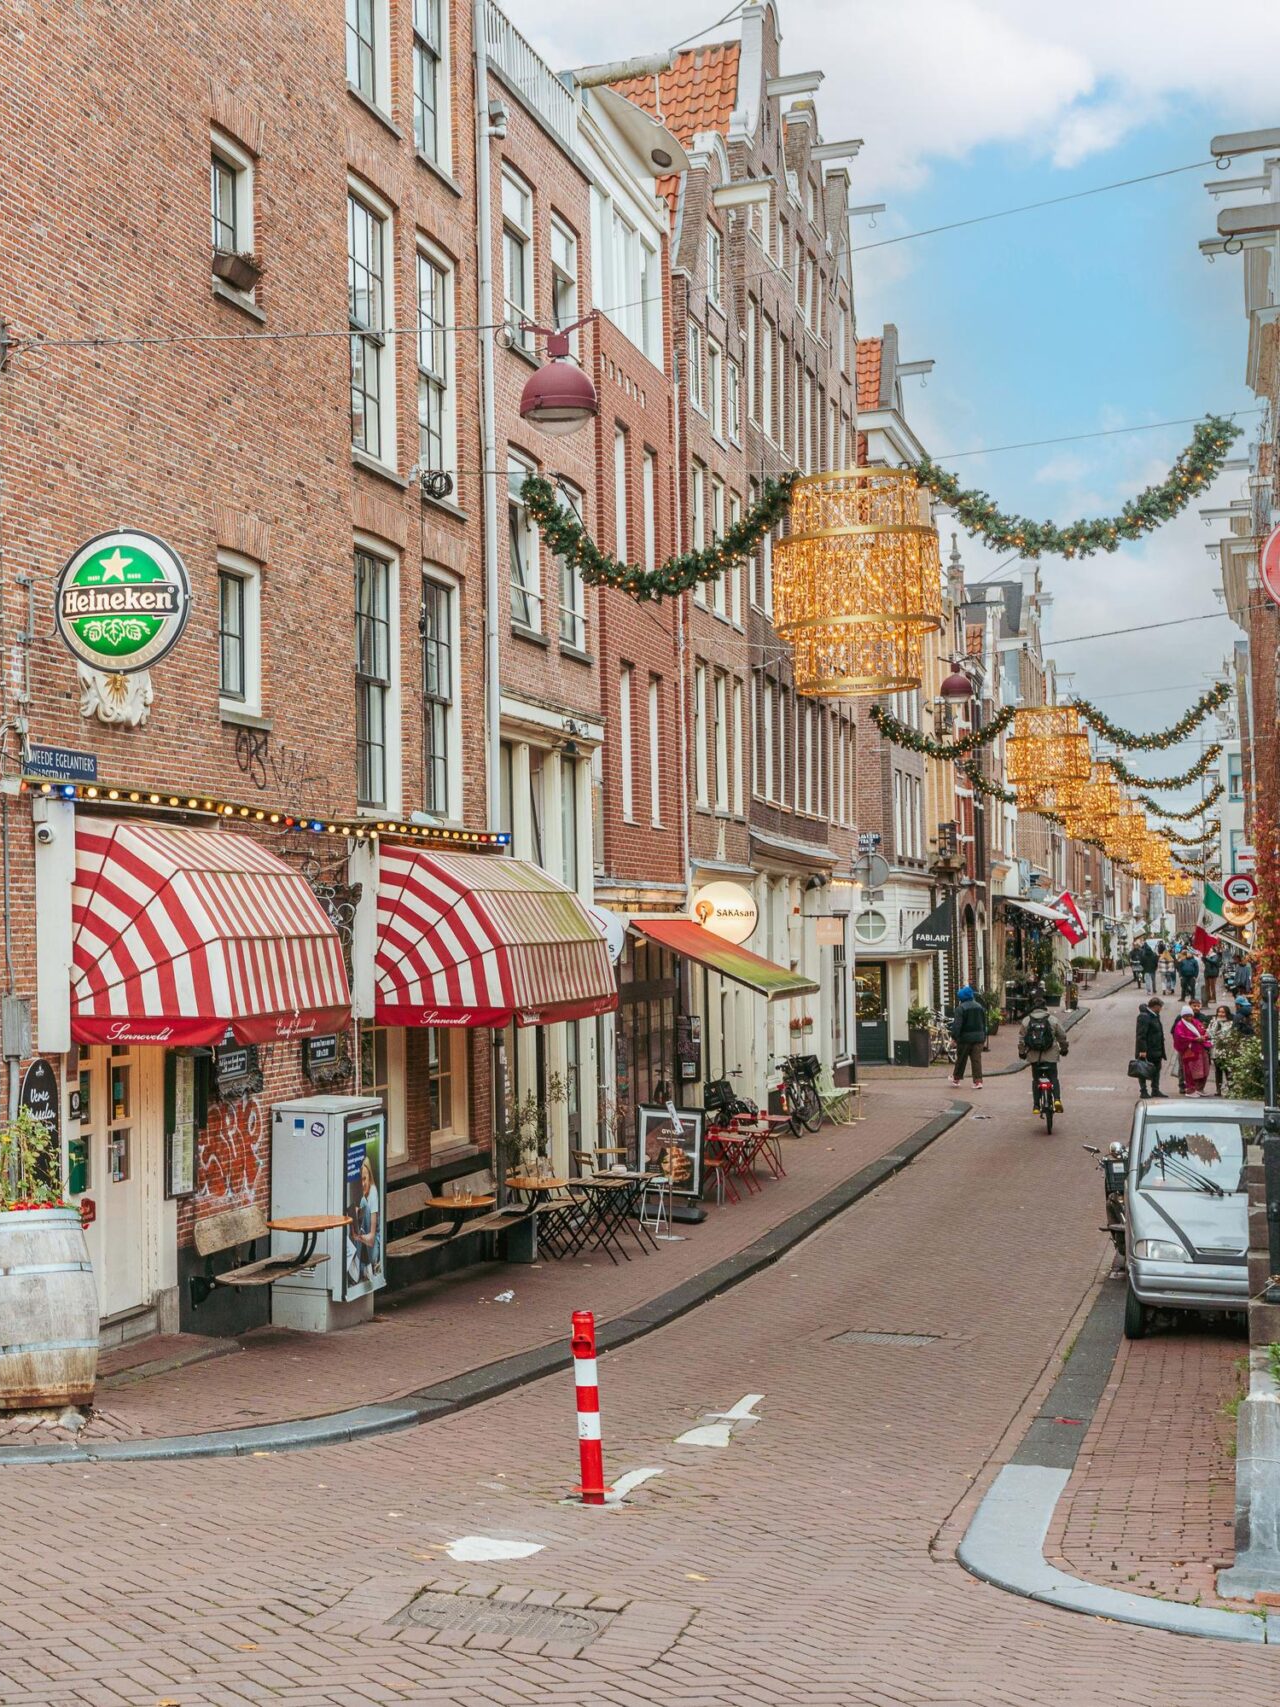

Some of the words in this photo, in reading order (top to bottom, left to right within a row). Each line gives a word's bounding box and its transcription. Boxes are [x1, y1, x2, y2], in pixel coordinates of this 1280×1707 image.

[65, 587, 173, 613] Heineken
[55, 753, 94, 772] EGELANTIERS
[716, 909, 755, 917] SAKAsan
[916, 934, 950, 942] FABI.ART
[420, 1010, 472, 1024] Sonneveld
[106, 1022, 174, 1041] Sonneveld
